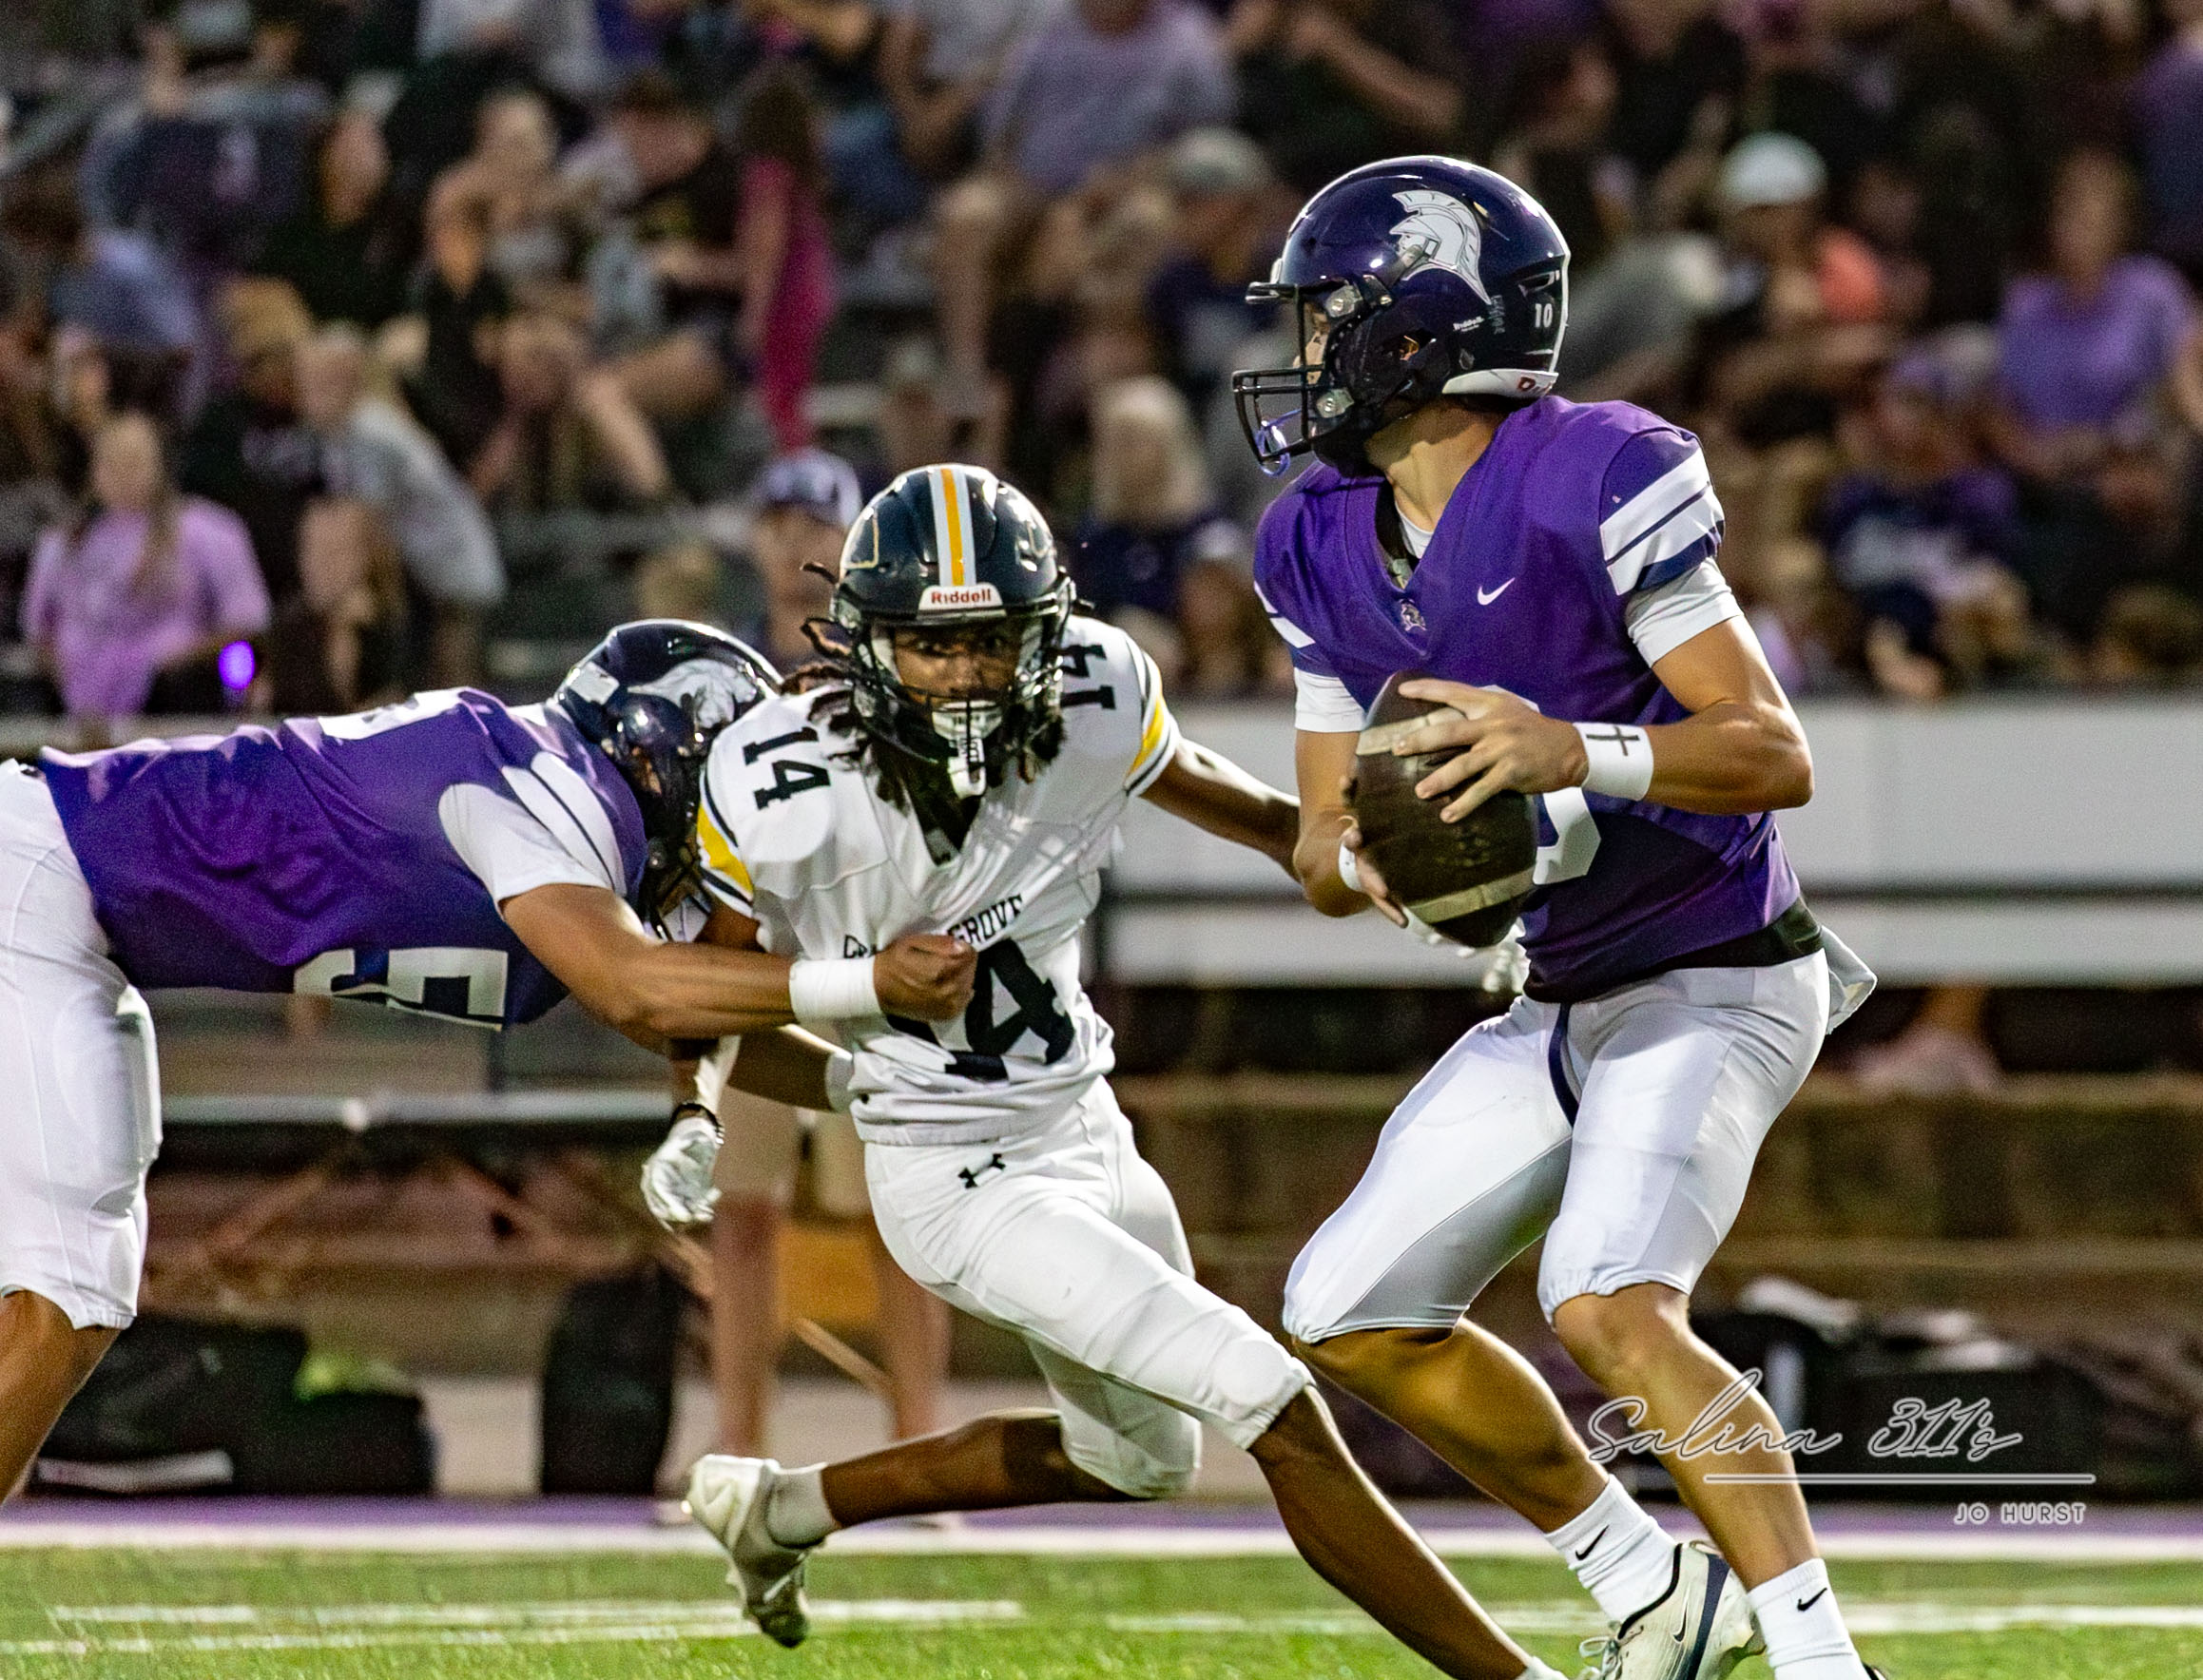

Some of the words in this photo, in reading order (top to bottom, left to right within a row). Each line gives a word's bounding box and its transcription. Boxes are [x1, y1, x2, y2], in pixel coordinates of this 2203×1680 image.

[1535, 302, 1553, 328] 10
[931, 589, 992, 605] Riddell
[742, 726, 831, 811] 14
